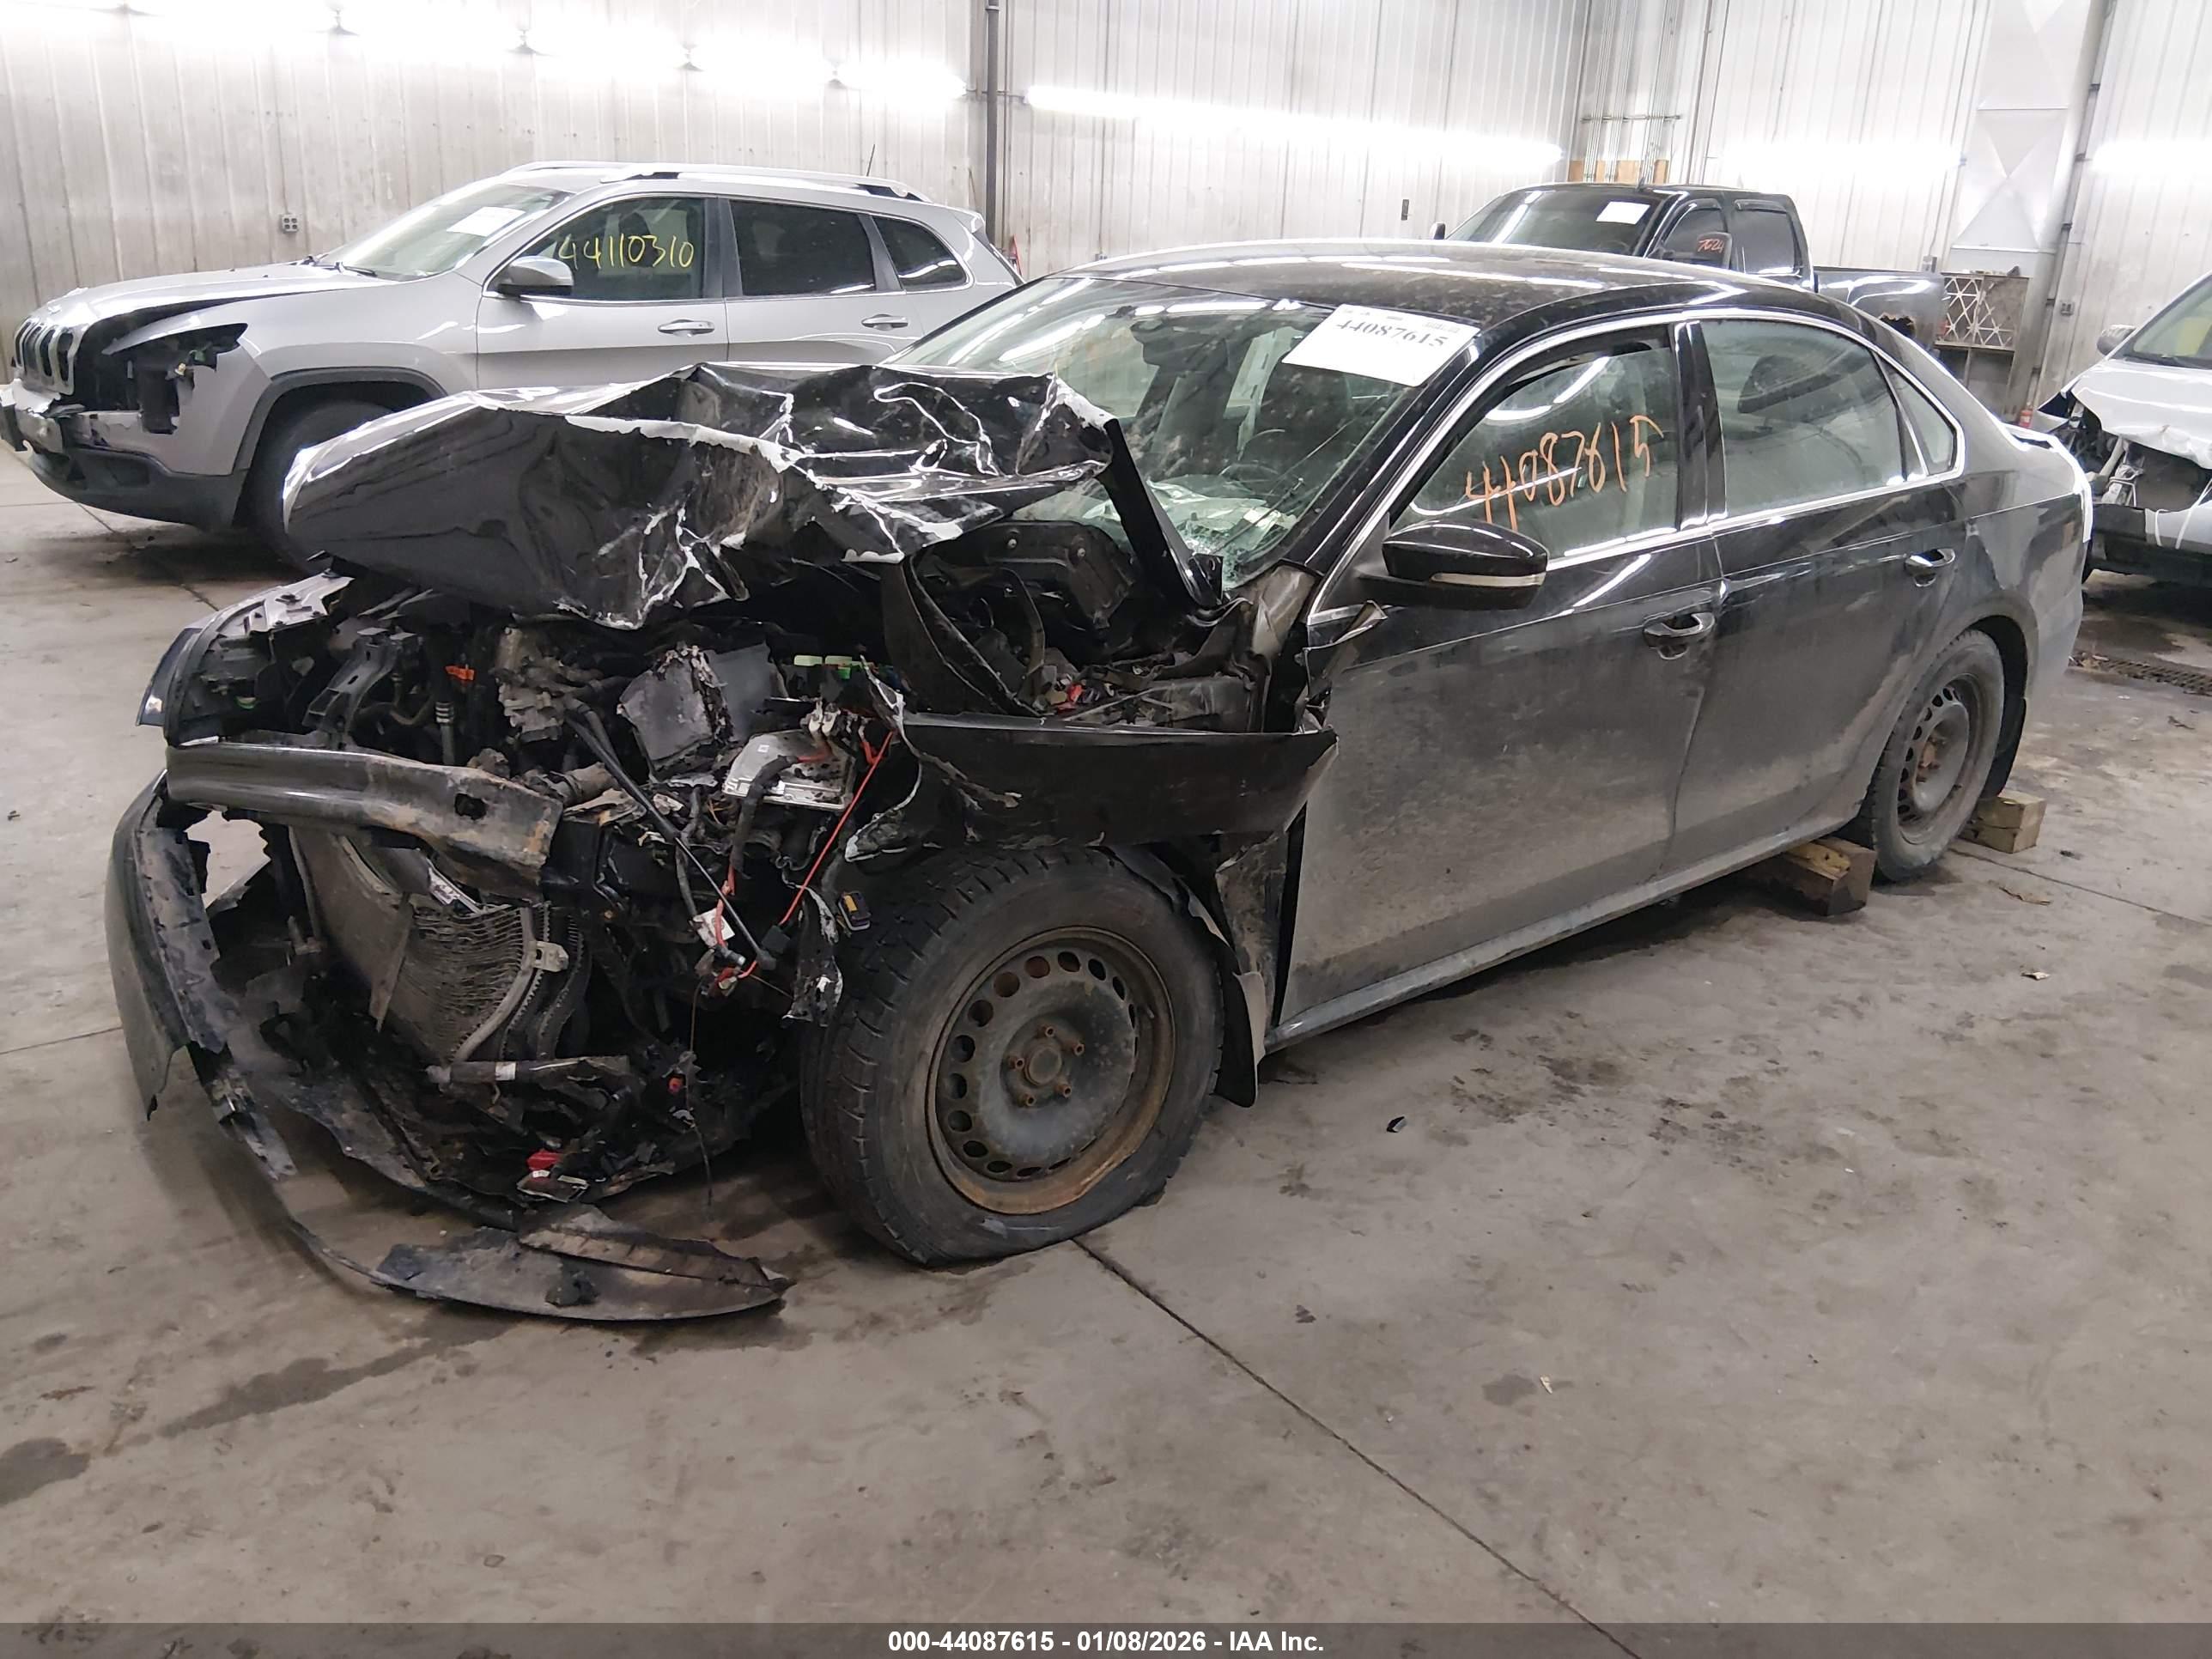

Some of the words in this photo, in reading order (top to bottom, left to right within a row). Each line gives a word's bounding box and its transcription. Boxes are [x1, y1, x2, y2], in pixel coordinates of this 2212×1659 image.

[557, 233, 695, 270] 44110310
[1336, 319, 1449, 348] 44087615
[1465, 415, 1665, 532] 44087615
